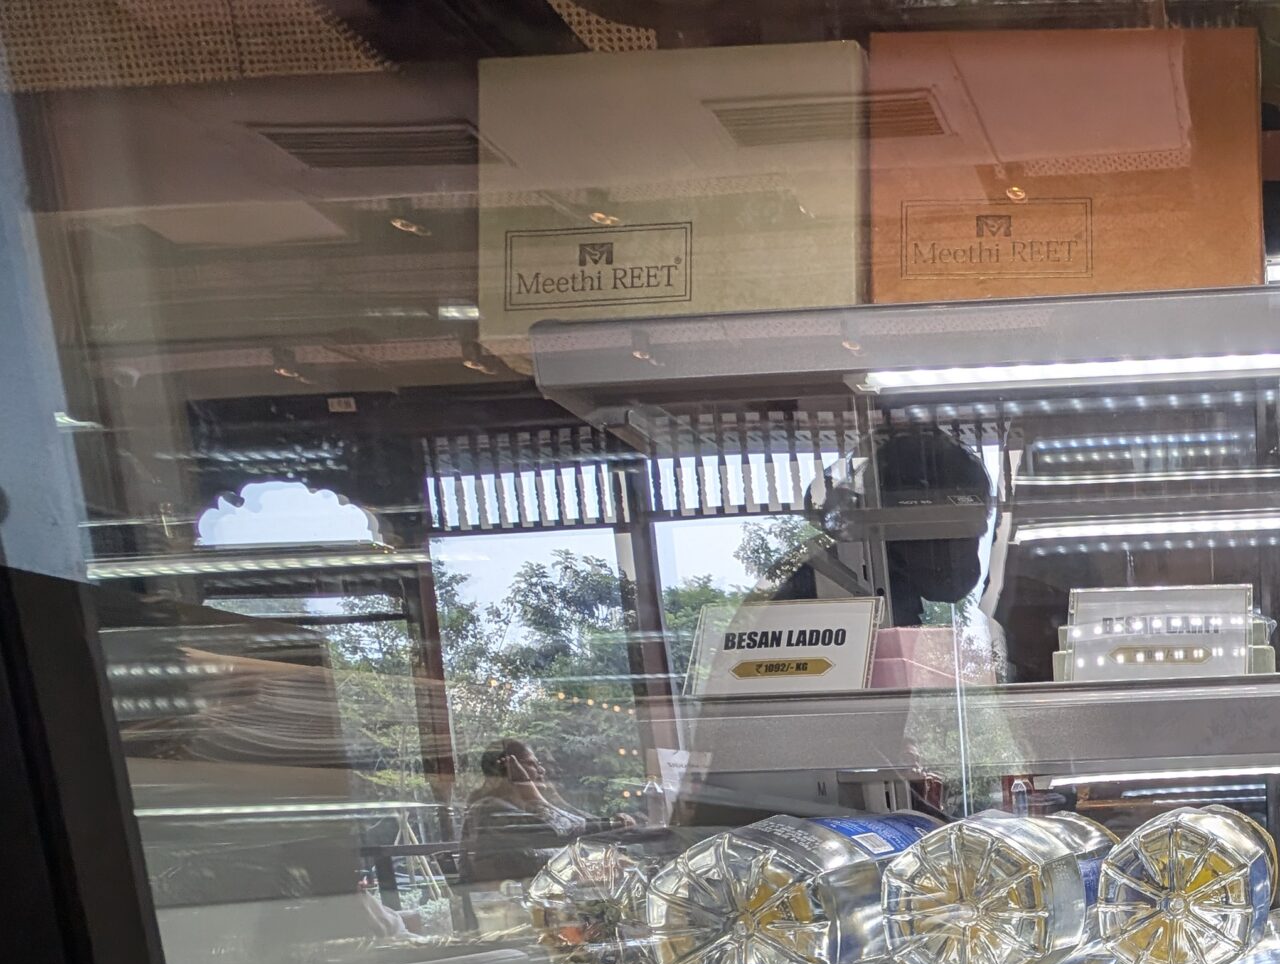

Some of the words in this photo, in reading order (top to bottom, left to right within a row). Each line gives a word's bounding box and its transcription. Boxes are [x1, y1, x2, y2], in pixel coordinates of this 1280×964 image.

[912, 240, 1000, 265] Meethi
[1010, 239, 1078, 264] REET
[516, 266, 602, 295] Meethi
[611, 264, 678, 291] REET
[723, 630, 783, 651] BESAN
[786, 628, 847, 647] LADOO
[795, 662, 809, 672] KG
